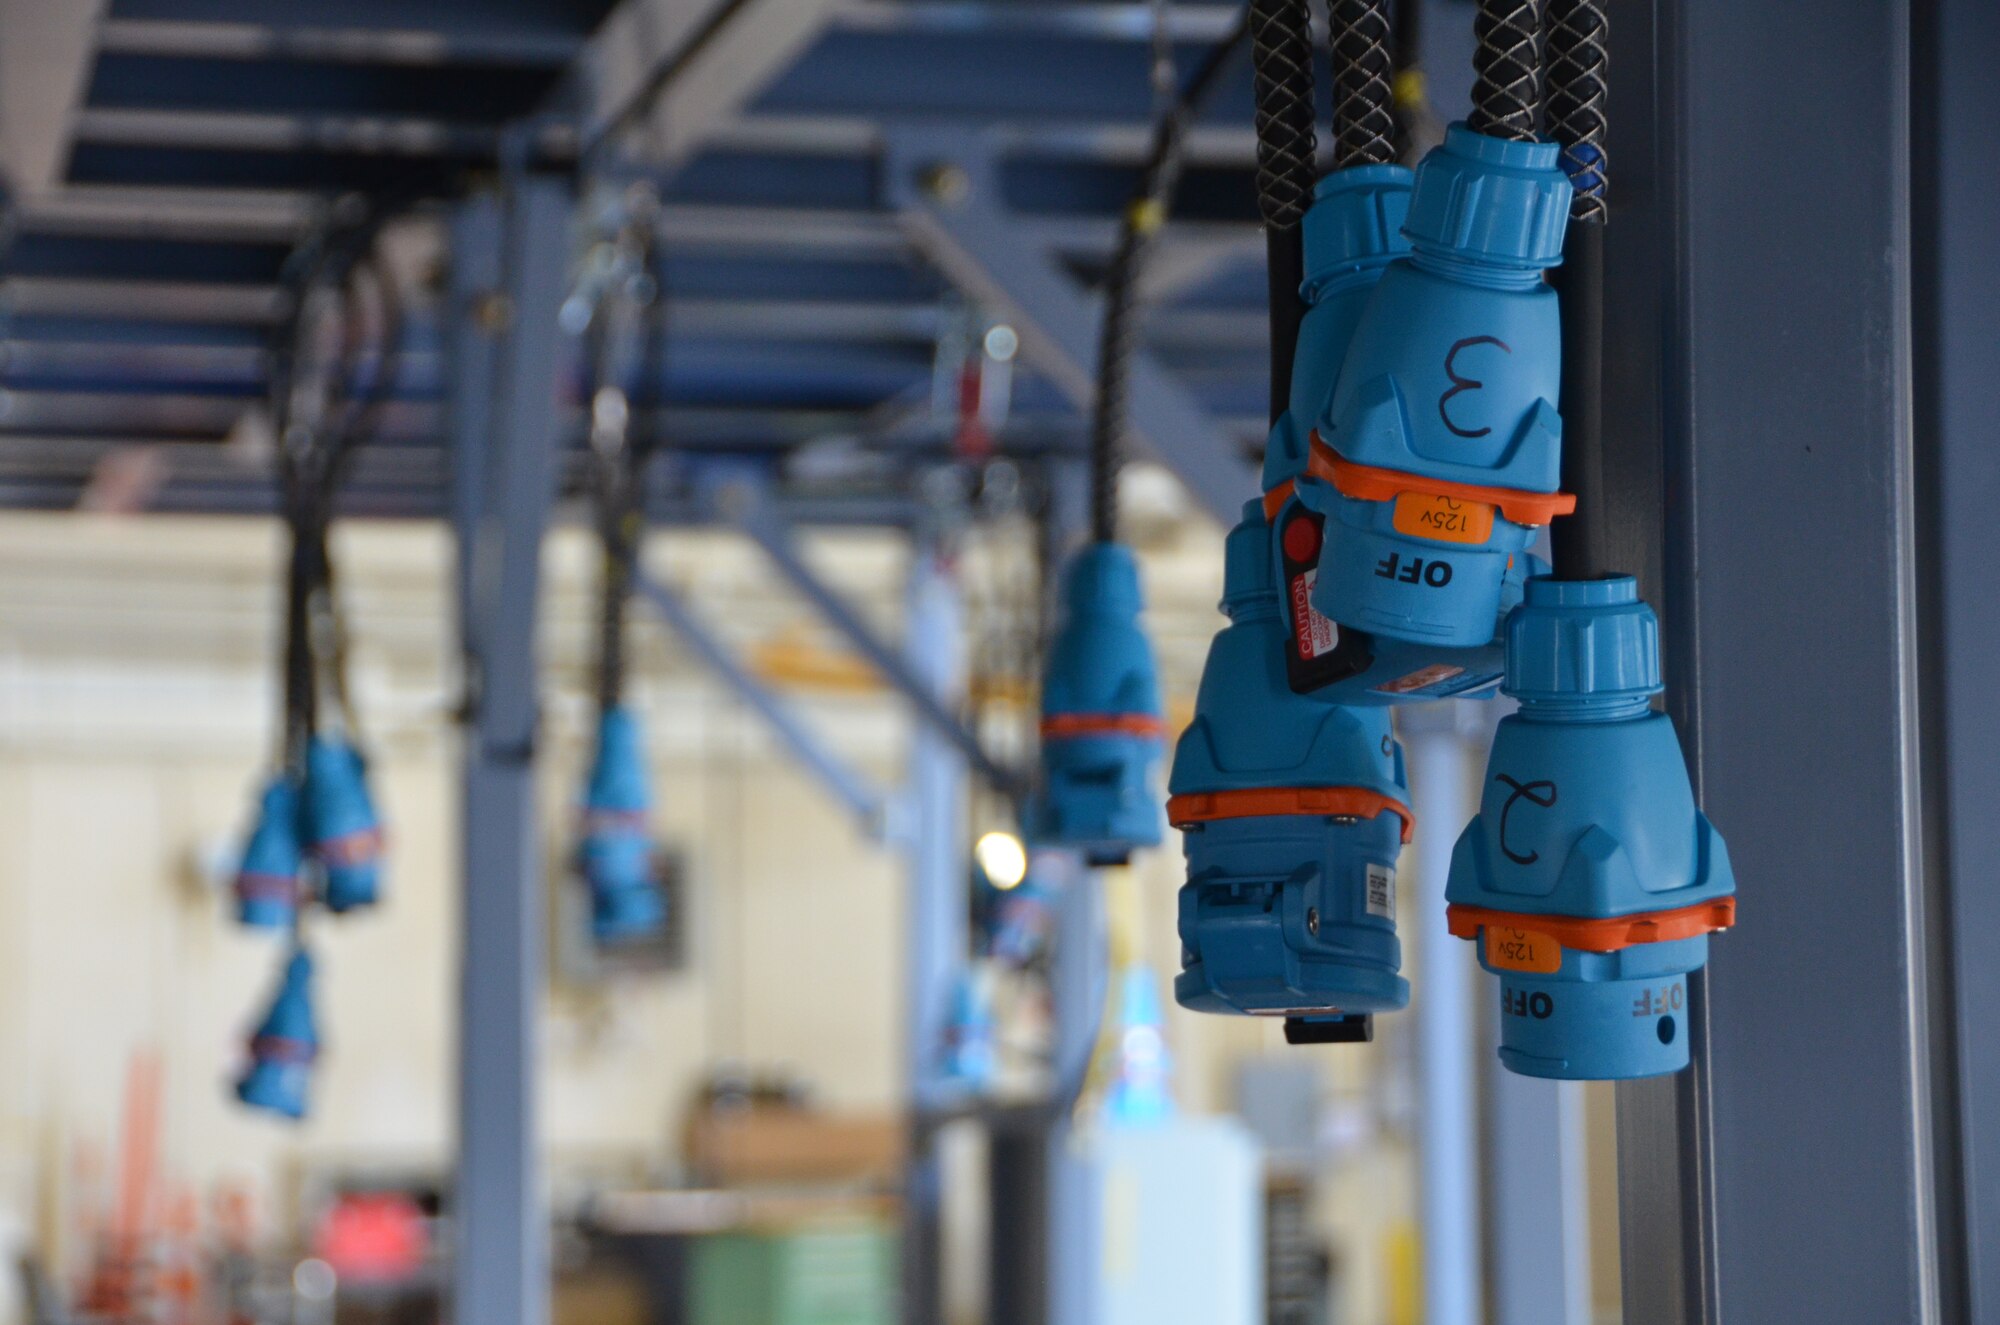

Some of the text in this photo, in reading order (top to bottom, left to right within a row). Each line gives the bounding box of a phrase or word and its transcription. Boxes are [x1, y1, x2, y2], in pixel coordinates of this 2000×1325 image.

[1438, 334, 1512, 438] 3
[1373, 552, 1454, 589] OFF
[1295, 580, 1312, 653] CAUTION
[1494, 773, 1558, 865] 2
[1503, 988, 1554, 1020] OFF
[1632, 983, 1683, 1017] OFF
